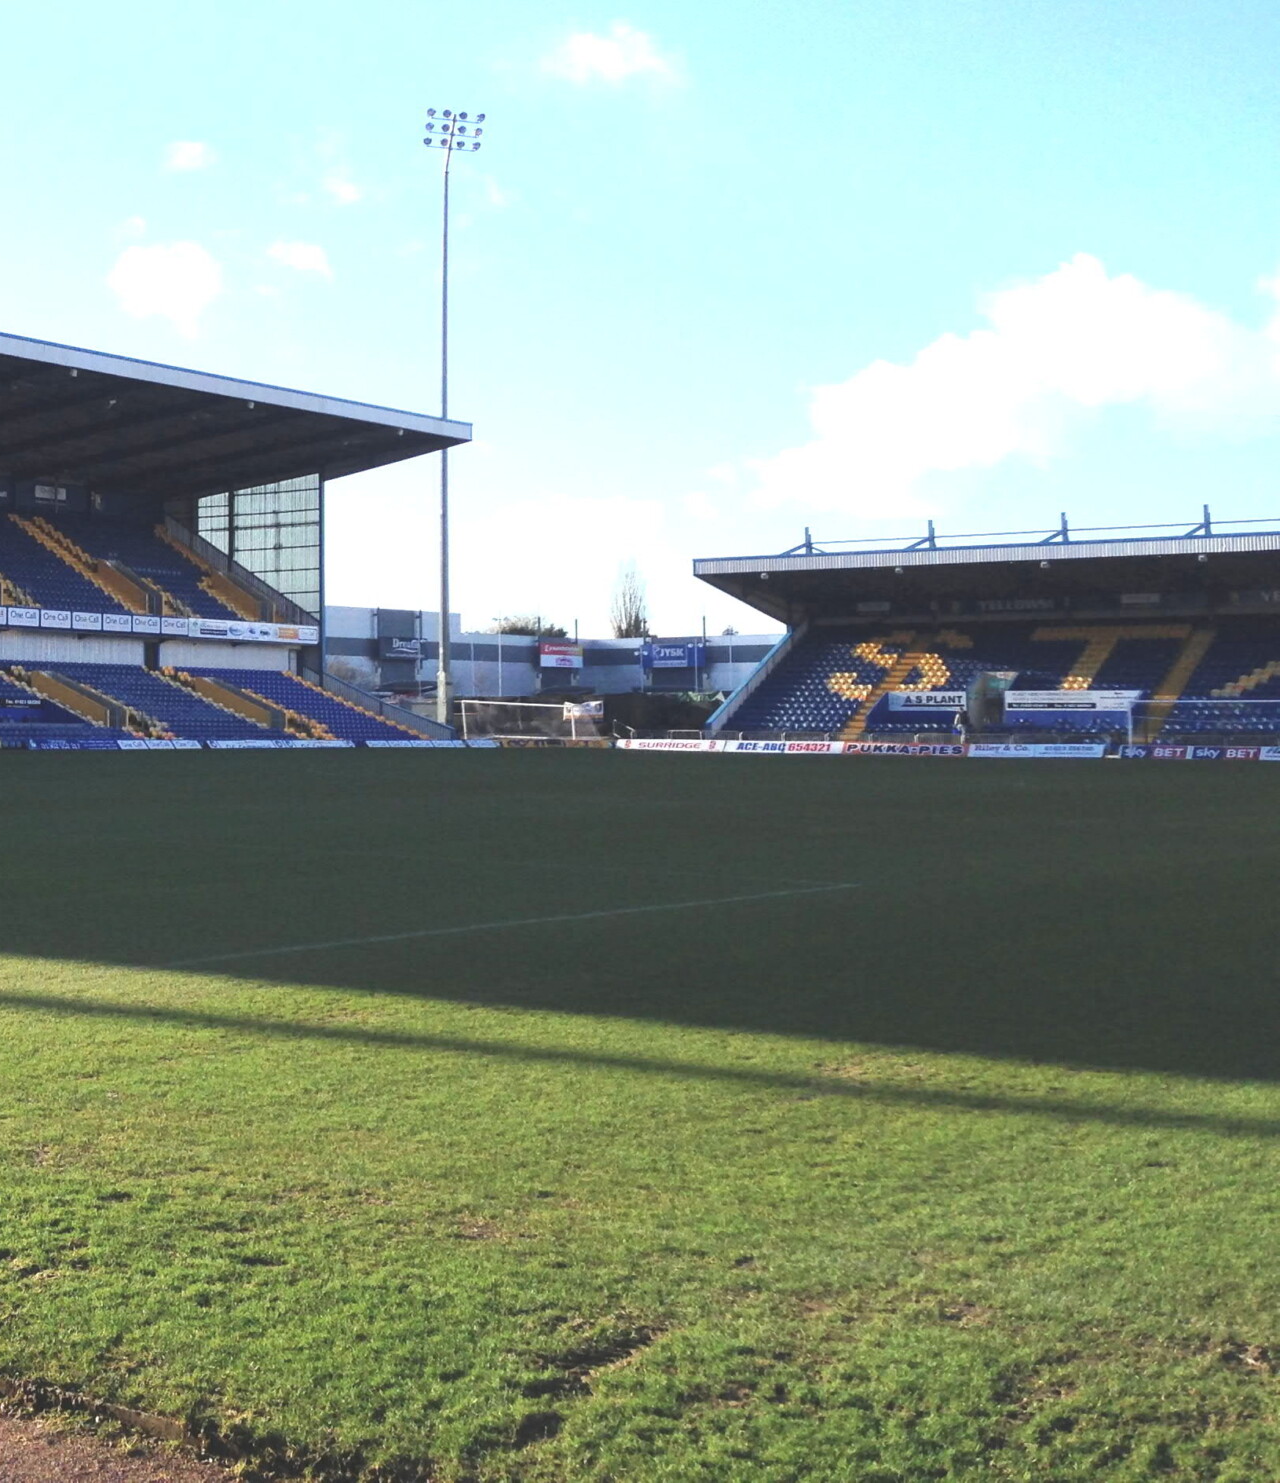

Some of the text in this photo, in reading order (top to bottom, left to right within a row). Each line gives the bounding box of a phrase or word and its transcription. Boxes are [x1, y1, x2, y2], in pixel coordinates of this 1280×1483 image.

[10, 611, 37, 620] One Call
[660, 648, 684, 657] JYSK
[904, 694, 963, 704] A S PLANT
[638, 742, 702, 750] SURRIDGE
[788, 743, 832, 752] 654321
[847, 744, 964, 755] PUKKA-PIES
[1124, 748, 1184, 759] sky BET
[1195, 748, 1220, 759] sky
[1225, 749, 1257, 758] BET
